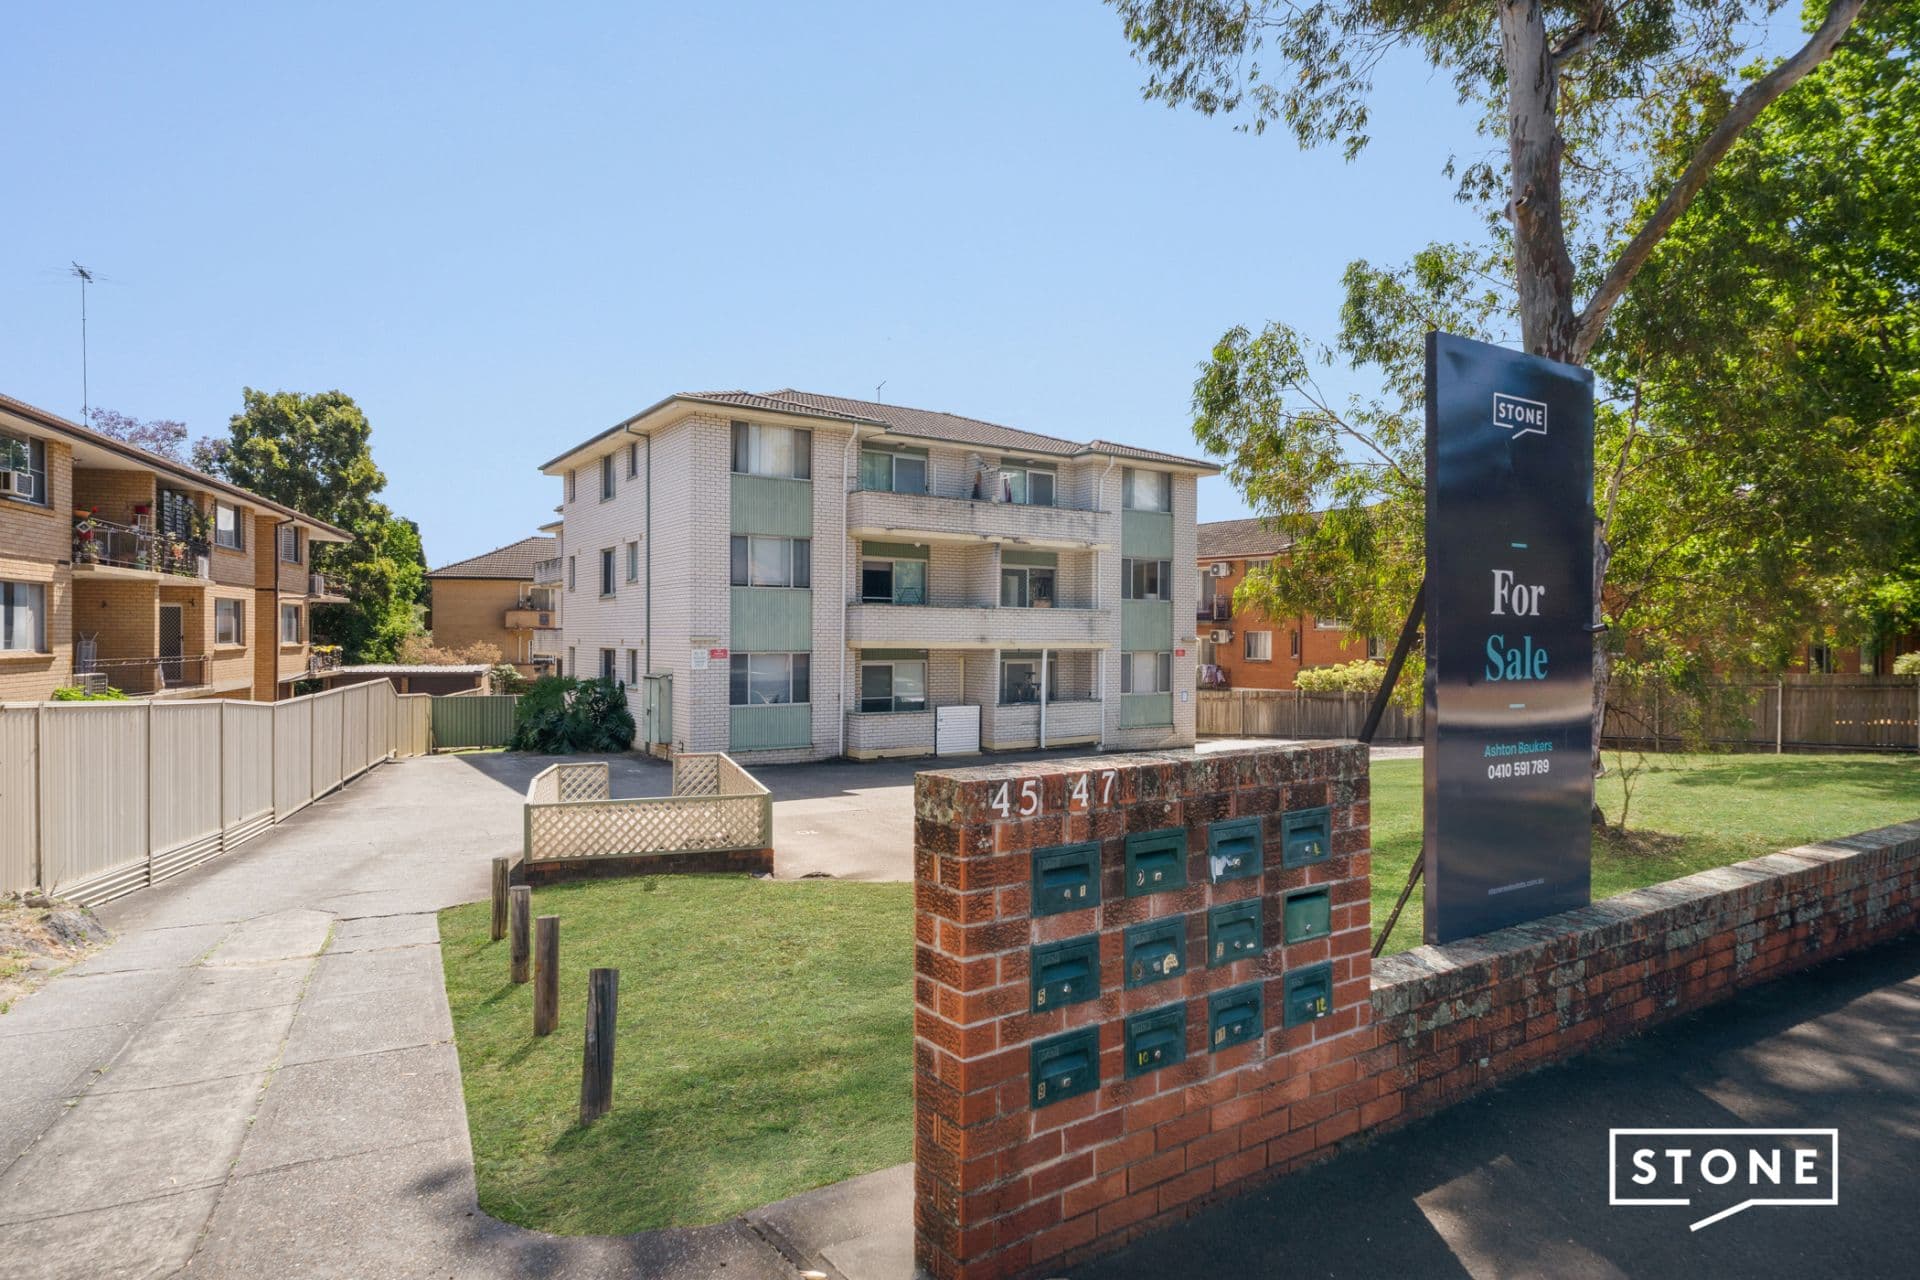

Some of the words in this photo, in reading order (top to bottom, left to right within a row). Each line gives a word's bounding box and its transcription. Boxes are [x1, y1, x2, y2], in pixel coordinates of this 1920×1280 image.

[1499, 402, 1543, 426] STONE
[1490, 569, 1545, 616] For
[1485, 634, 1548, 681] Sale
[1484, 743, 1517, 758] Ashton
[1518, 740, 1553, 754] Beukers
[1488, 763, 1512, 779] 0410
[1514, 761, 1530, 776] 591
[1531, 759, 1550, 774] 789
[992, 780, 1038, 817] 45
[1072, 771, 1115, 807] 47
[1139, 1052, 1149, 1066] 10
